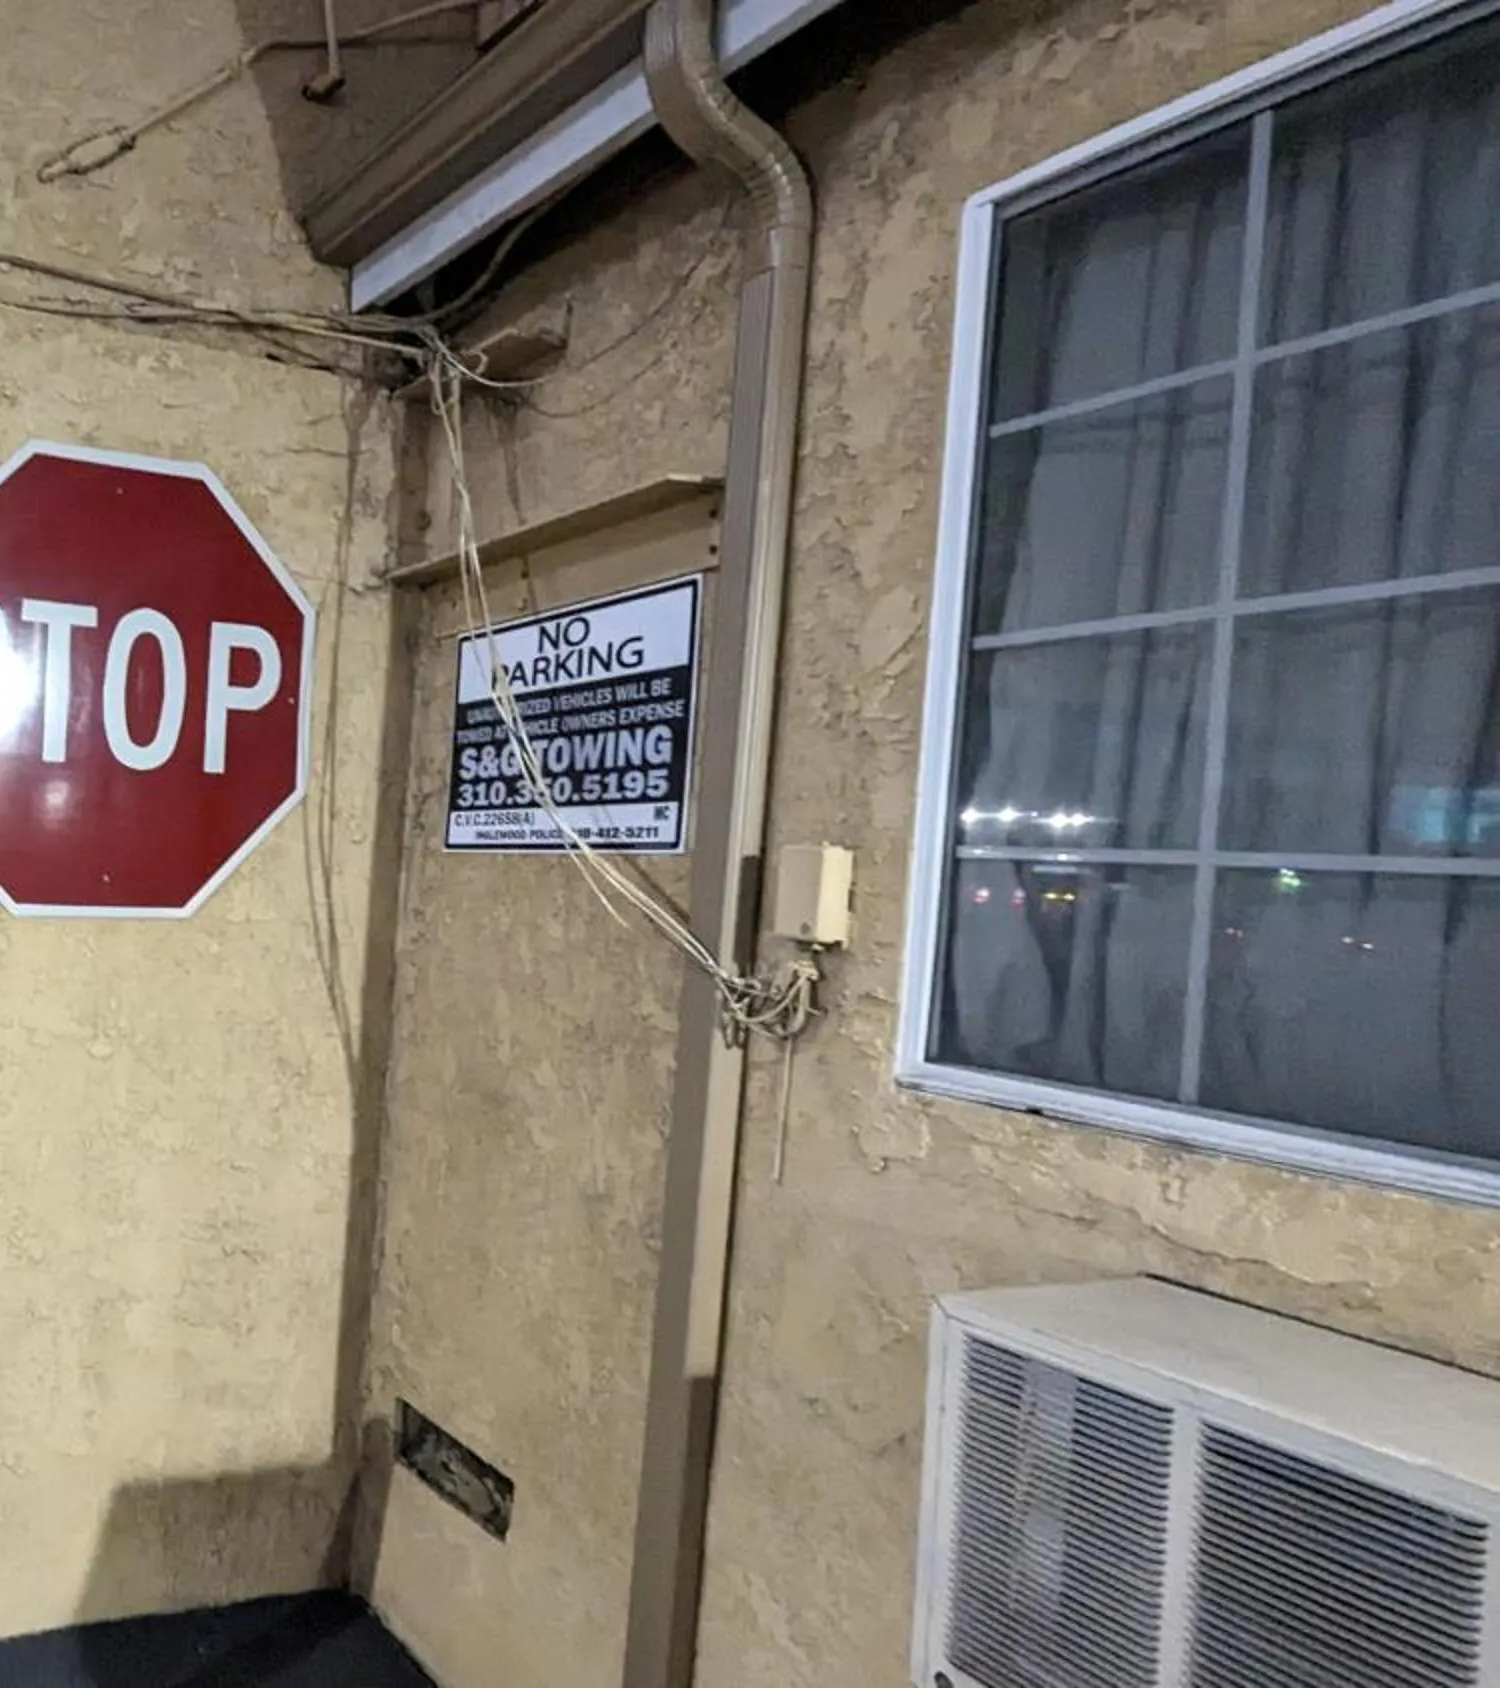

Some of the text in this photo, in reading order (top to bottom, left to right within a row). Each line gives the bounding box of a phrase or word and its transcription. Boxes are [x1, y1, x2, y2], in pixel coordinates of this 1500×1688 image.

[538, 616, 590, 654] NO
[491, 635, 645, 690] PARKING
[553, 687, 614, 713] VEHICLES
[615, 681, 649, 703] WILL
[650, 677, 673, 698] BE
[561, 709, 617, 732] OWNERS
[619, 698, 686, 725] EXPENSE
[459, 724, 674, 780] S&G TOWING
[571, 825, 660, 839] 10-412-5211
